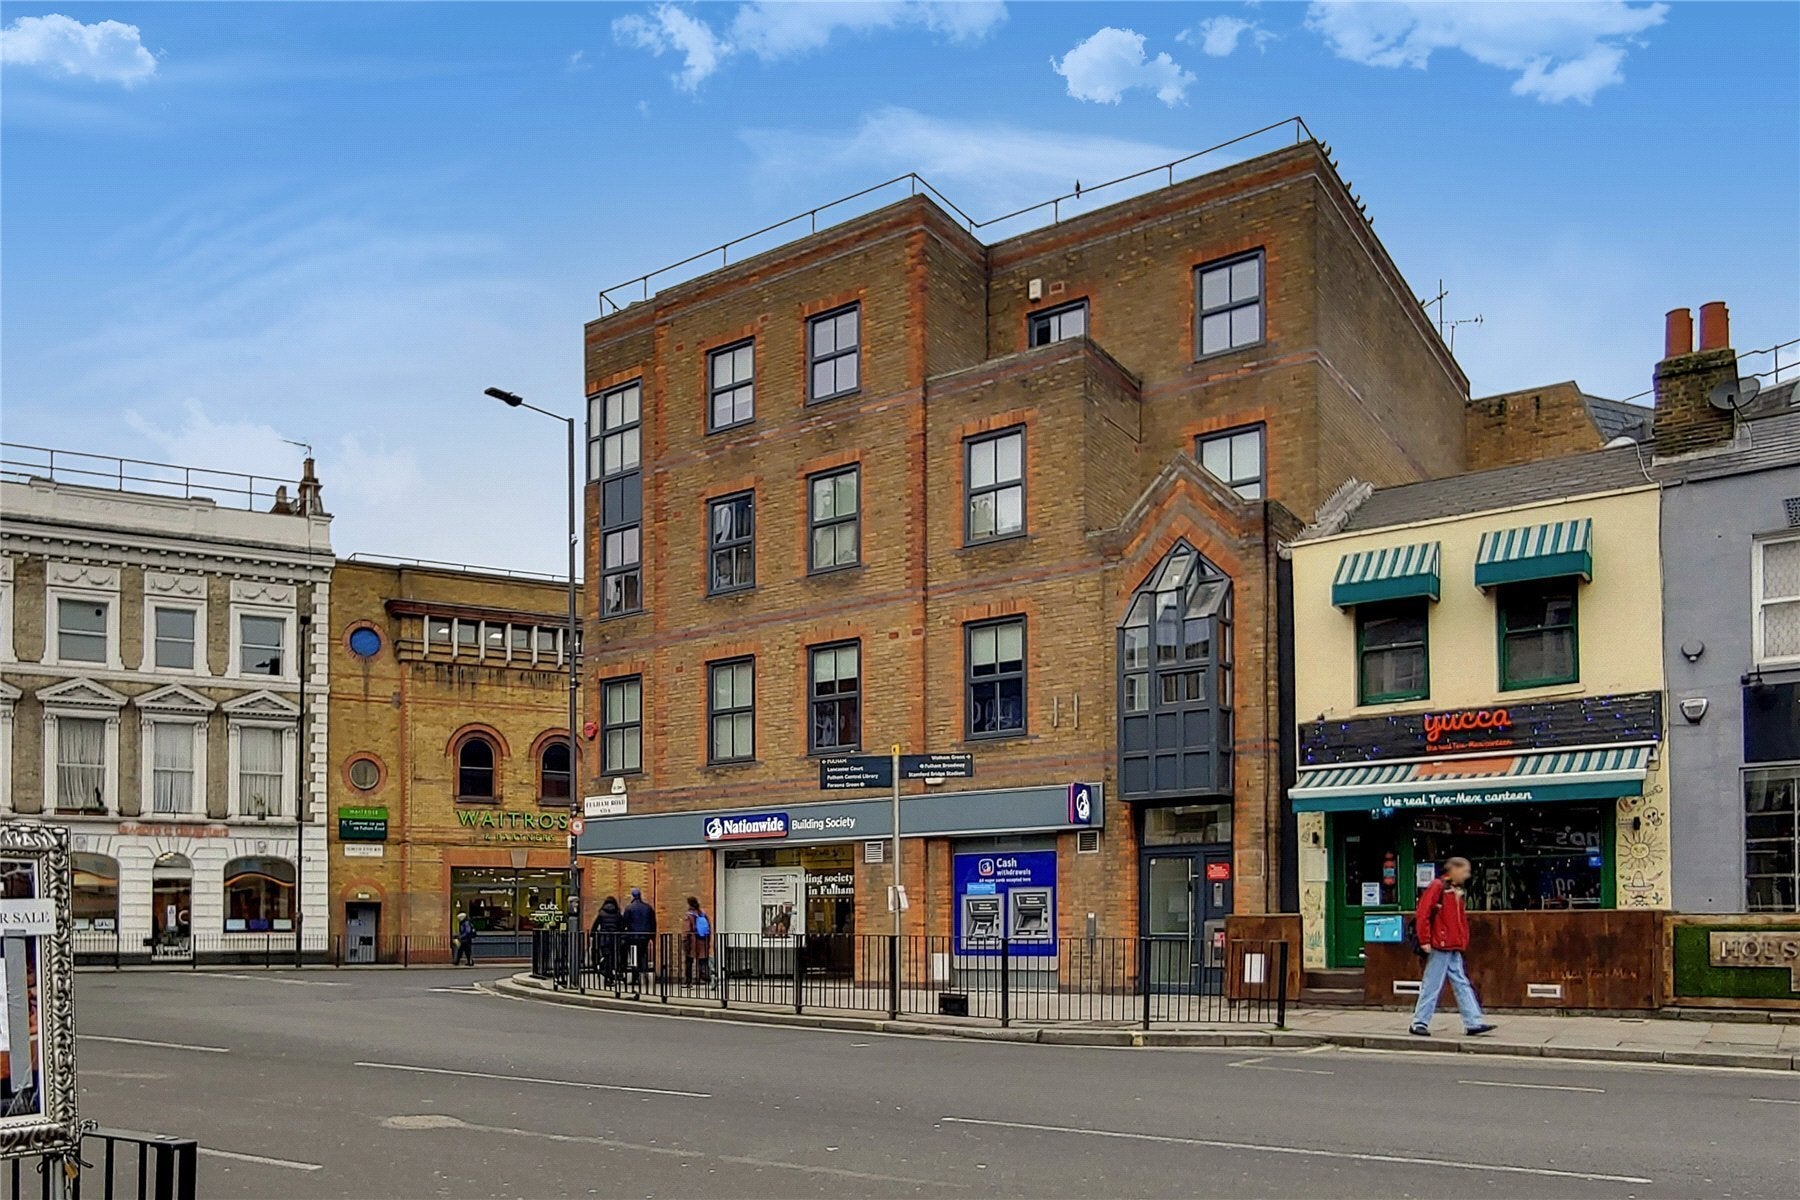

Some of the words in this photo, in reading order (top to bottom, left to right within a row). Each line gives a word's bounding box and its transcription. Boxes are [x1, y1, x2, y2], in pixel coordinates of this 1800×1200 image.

[1424, 709, 1512, 742] yucca
[1383, 796, 1401, 807] the
[1403, 794, 1427, 806] real
[1428, 792, 1483, 805] Tex-Mex
[1484, 790, 1533, 802] canteen
[457, 809, 568, 830] WAITROS
[723, 817, 784, 834] Nationwide
[791, 819, 824, 830] Building
[825, 816, 856, 829] Society
[496, 833, 555, 842] PARTNERS
[996, 857, 1017, 868] Cash
[996, 868, 1031, 876] withdrawals
[824, 872, 854, 885] society
[808, 885, 818, 895] in
[820, 884, 854, 895] Fulham
[13, 911, 50, 923] SALE
